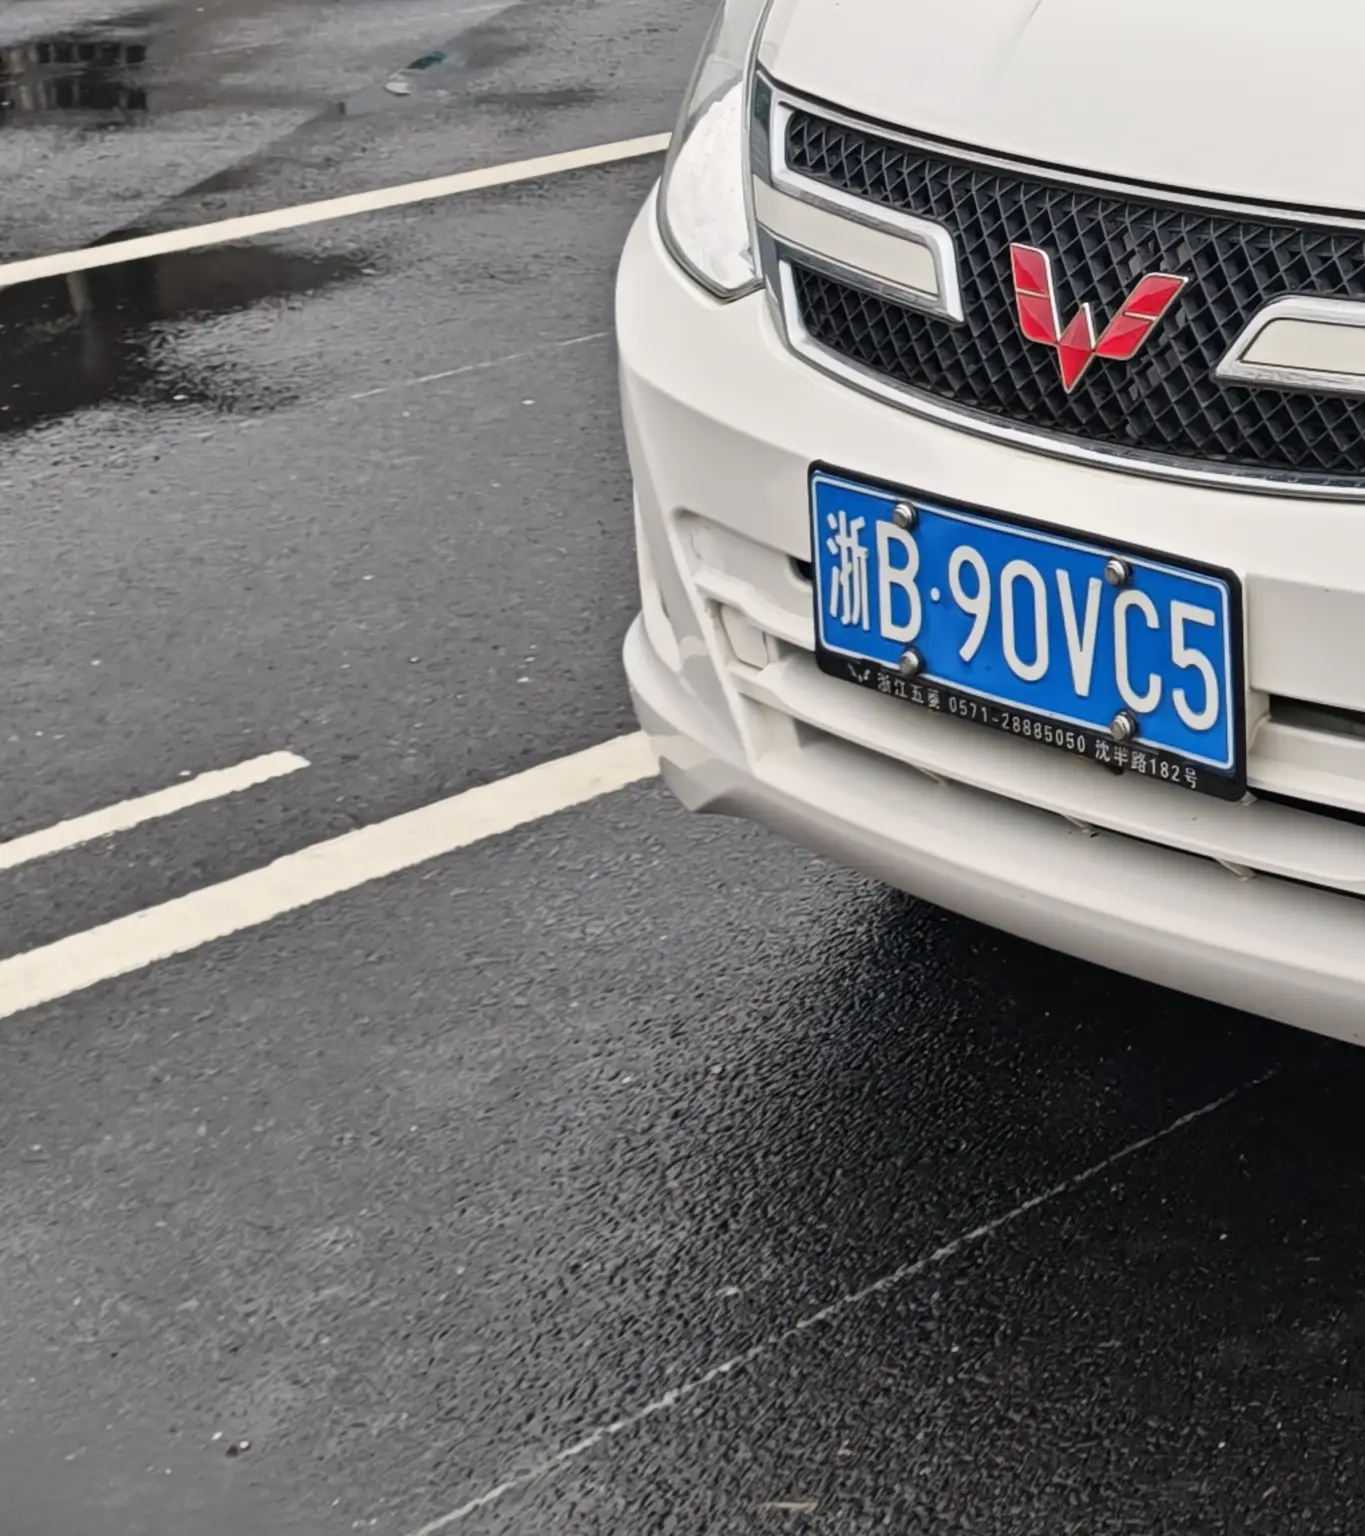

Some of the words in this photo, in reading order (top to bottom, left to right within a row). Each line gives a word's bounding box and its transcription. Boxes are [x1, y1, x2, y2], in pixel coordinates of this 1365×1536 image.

[826, 510, 1220, 731] 浙B·90VC5
[876, 673, 942, 711] 浙江五菱
[948, 695, 1087, 753] 0571-28885050
[1094, 738, 1199, 789] 沈半路182号
